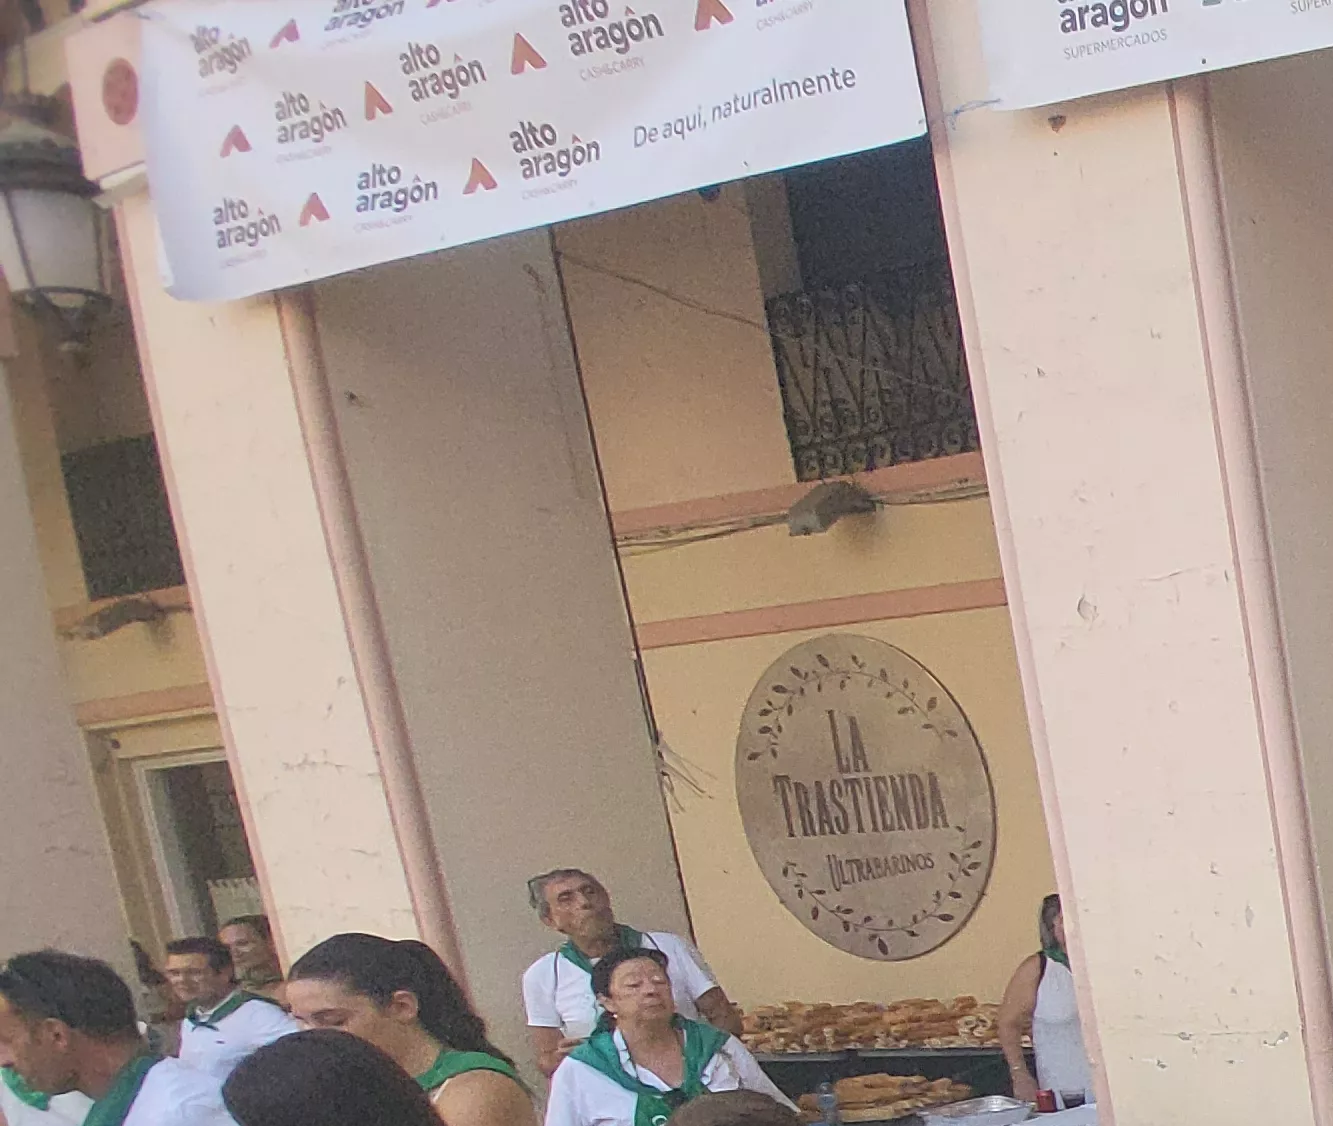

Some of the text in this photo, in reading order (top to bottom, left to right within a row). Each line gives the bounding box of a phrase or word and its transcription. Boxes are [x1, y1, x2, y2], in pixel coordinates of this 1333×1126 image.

[559, 0, 610, 28] alto
[399, 42, 440, 76] alto
[1063, 28, 1169, 60] SUPERMERCADOS
[274, 91, 310, 122] alto
[633, 126, 658, 148] De
[712, 66, 857, 124] naturalmente
[509, 120, 557, 154] alto
[356, 163, 401, 191] alto
[212, 198, 249, 225] alto
[827, 709, 872, 774] LA
[772, 772, 950, 838] TRASTIENDA
